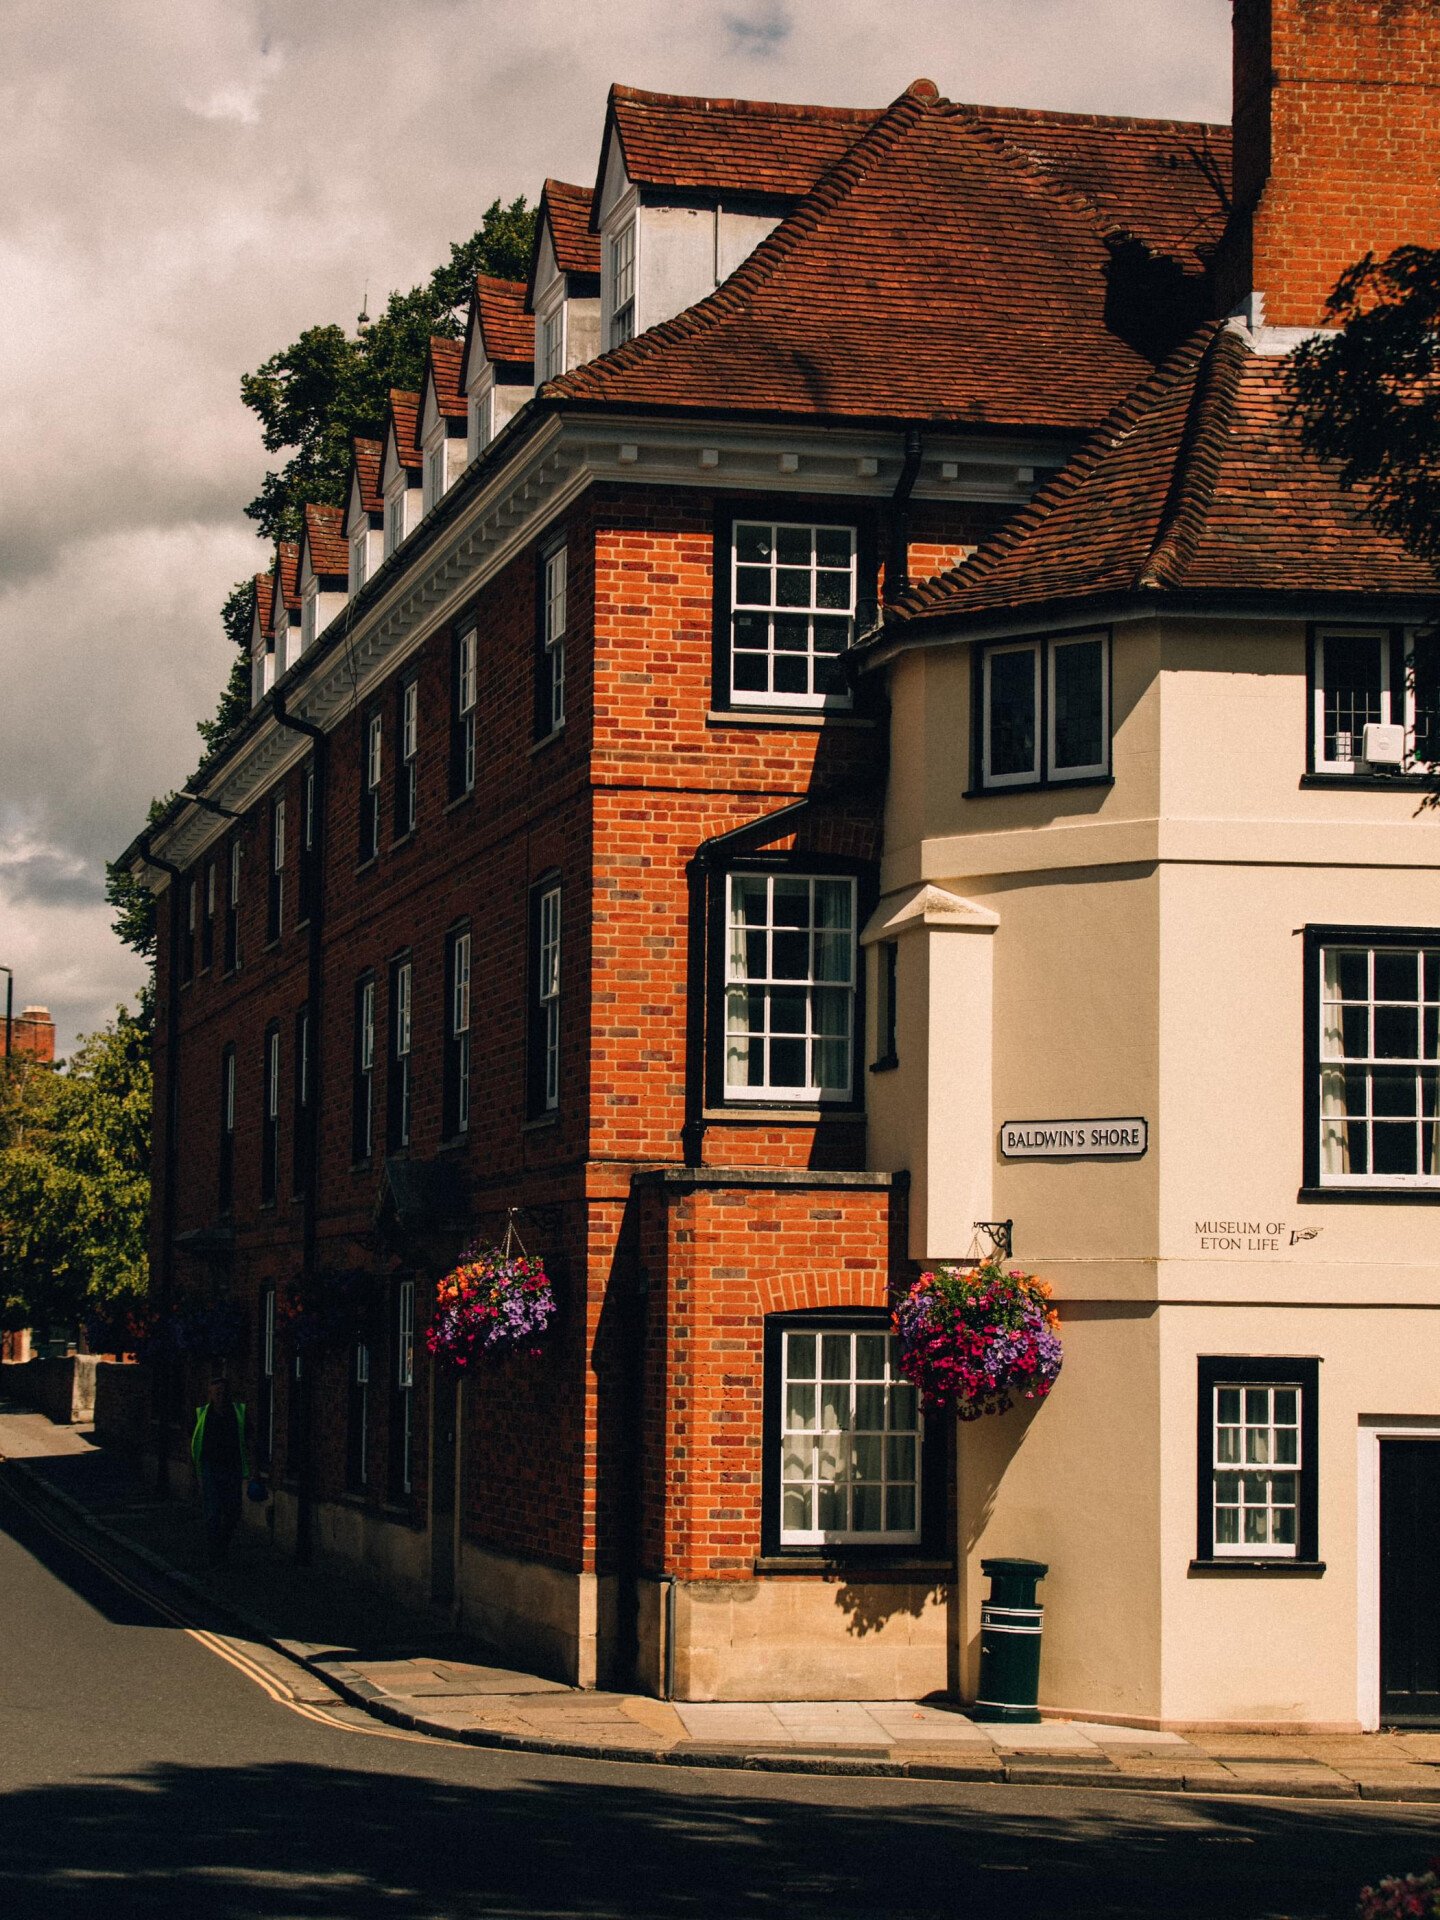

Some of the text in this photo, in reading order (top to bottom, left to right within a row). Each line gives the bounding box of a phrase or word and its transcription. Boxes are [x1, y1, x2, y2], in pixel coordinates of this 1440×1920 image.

[1008, 1128, 1140, 1148] BALDWIN'S SHORE
[1195, 1222, 1286, 1235] MUSEUM OF
[1201, 1237, 1279, 1251] ETON LIFE
